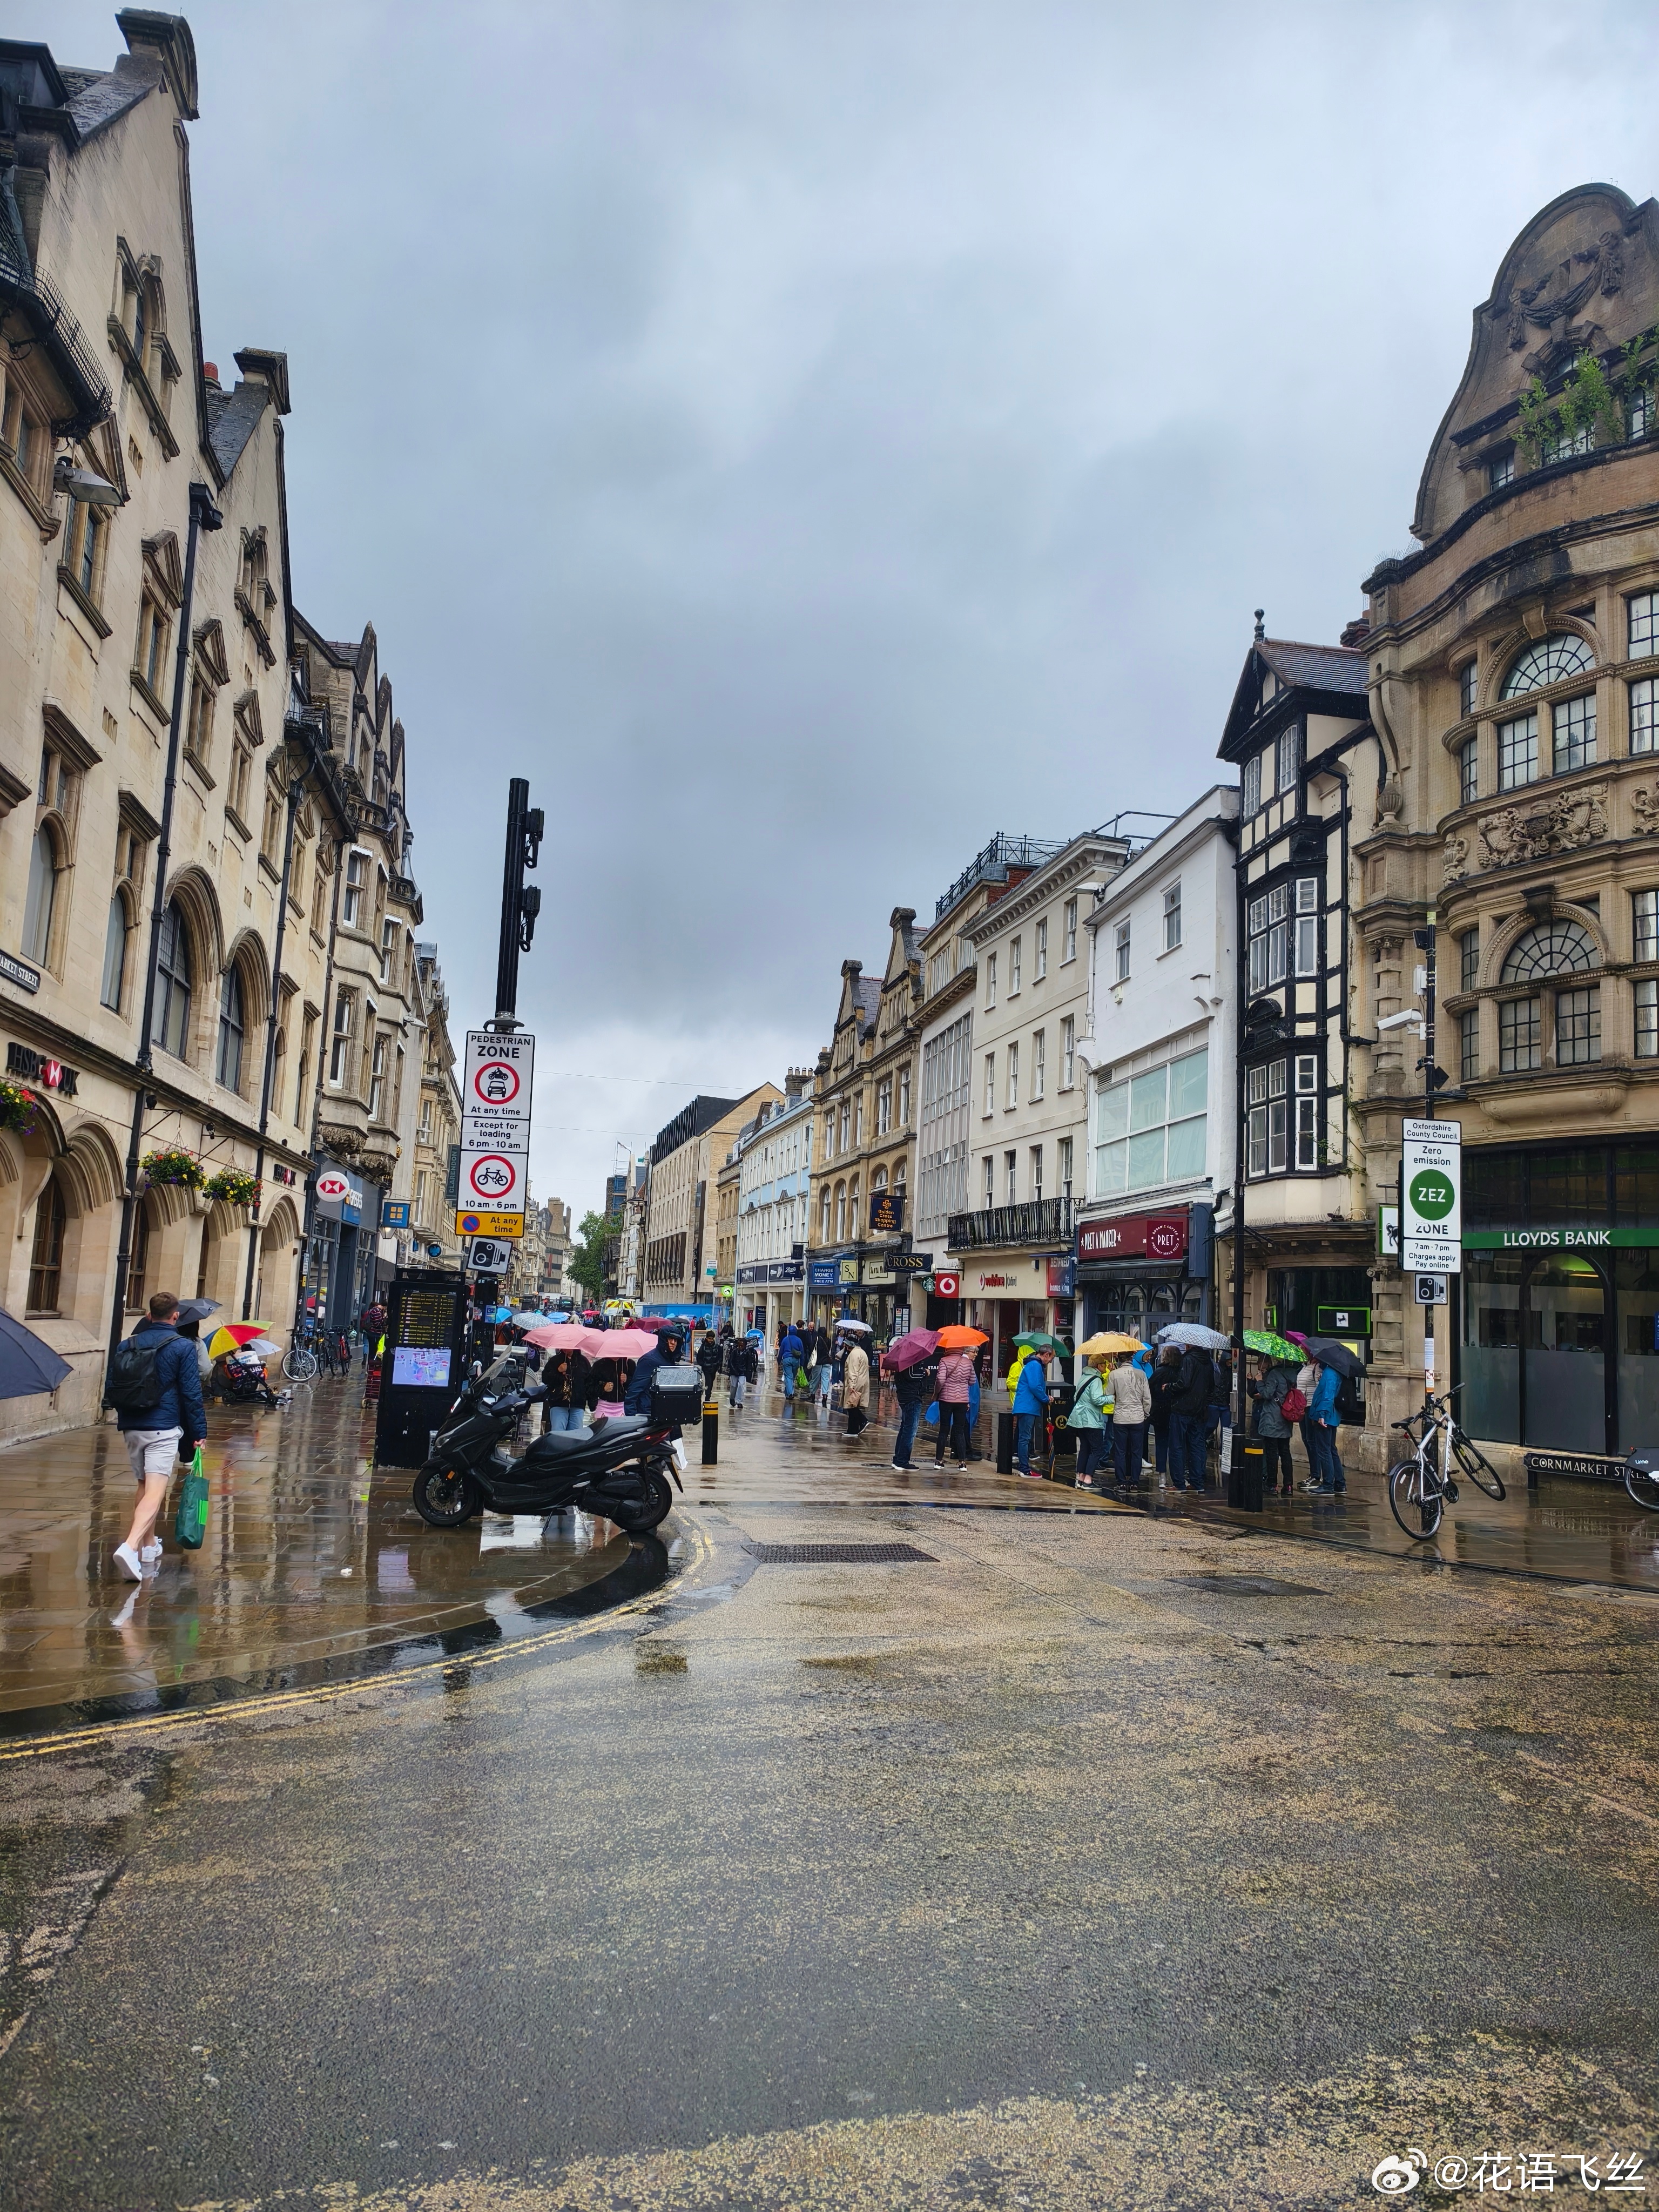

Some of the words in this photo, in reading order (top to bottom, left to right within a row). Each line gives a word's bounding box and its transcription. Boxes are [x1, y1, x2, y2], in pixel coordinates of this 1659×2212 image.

[0, 955, 17, 975] ARKET
[18, 967, 38, 987] STREET
[471, 1035, 530, 1046] PEDESTRIAN
[477, 1046, 520, 1058] ZONE
[8, 1042, 46, 1081] HSBC
[58, 1065, 80, 1095] UK
[474, 1121, 503, 1130] Except
[1413, 1123, 1451, 1131] Oxfordshire
[480, 1130, 511, 1139] loading
[1407, 1130, 1430, 1138] County
[1433, 1131, 1457, 1139] Council
[496, 1141, 506, 1149] 10
[1422, 1145, 1441, 1155] Zero
[1413, 1156, 1451, 1165] emission
[449, 1151, 457, 1193] CLARENDON
[1418, 1188, 1446, 1202] ZEZ
[1152, 1225, 1166, 1235] ORGANIC
[1415, 1223, 1448, 1235] ZONE
[1084, 1232, 1095, 1250] PRET
[1095, 1231, 1098, 1249] A
[1100, 1229, 1117, 1249] MANGER
[1157, 1234, 1174, 1246] PRET
[1504, 1232, 1560, 1246] LLOYDS
[1565, 1231, 1611, 1245] BANK
[887, 1257, 923, 1267] CROSS
[1050, 1257, 1069, 1267] BETFRED
[1408, 1252, 1436, 1261] Charges
[1438, 1254, 1456, 1262] apply
[1415, 1260, 1427, 1269] Pay
[985, 1274, 1005, 1287] vodafone
[1007, 1276, 1017, 1286] Oxford
[1049, 1283, 1061, 1291] bonus
[1061, 1283, 1069, 1294] king
[1531, 1457, 1609, 1475] CORNMARKET
